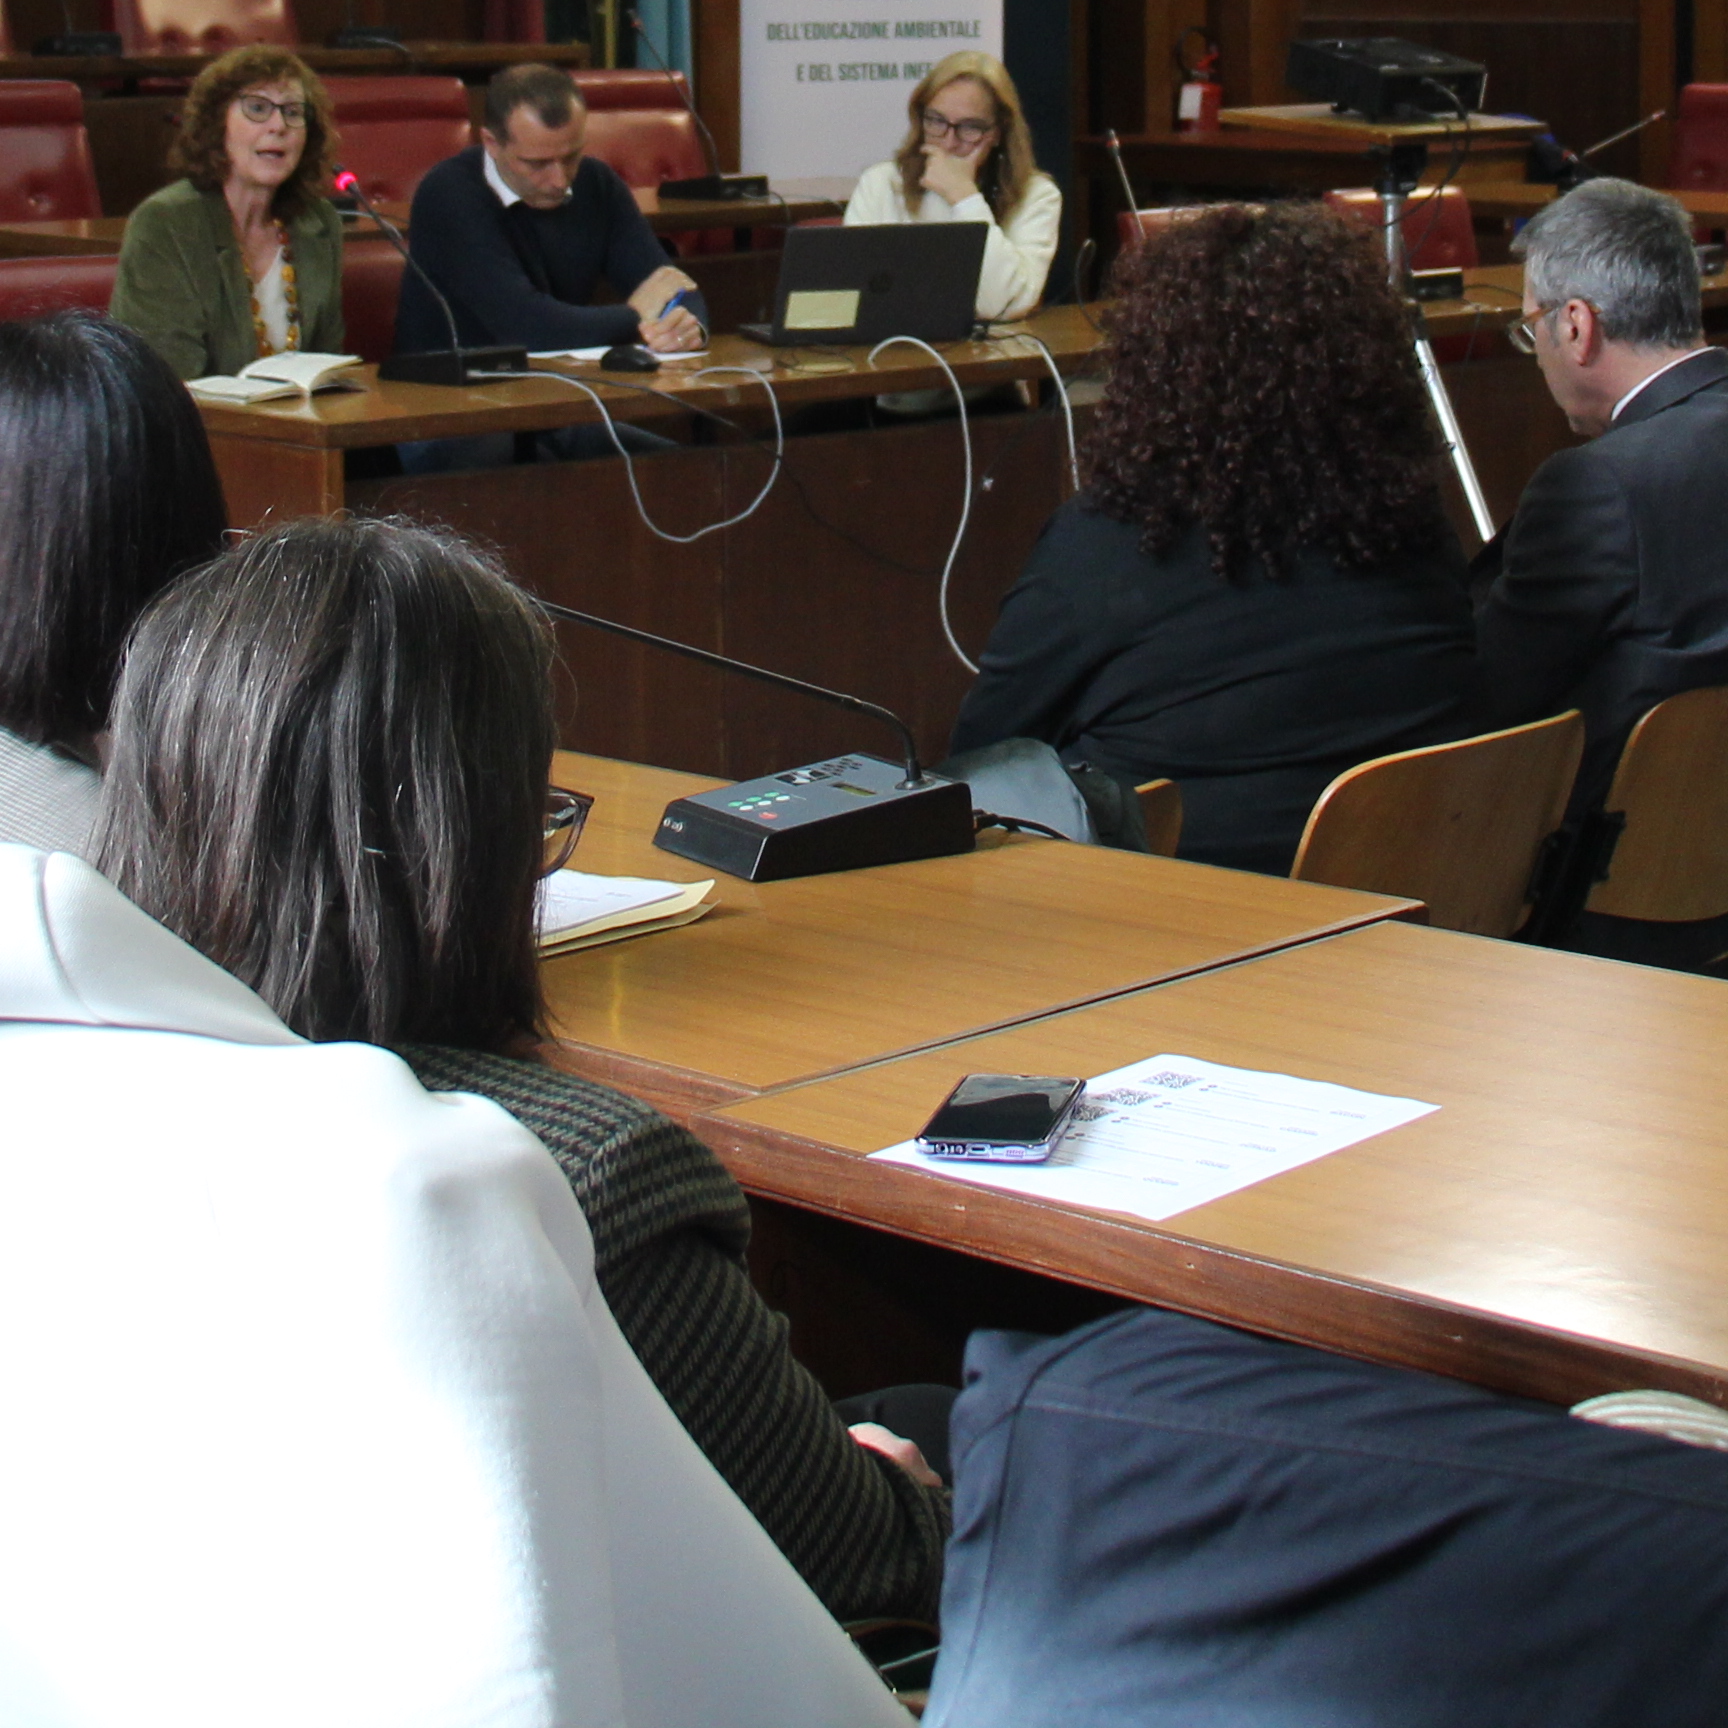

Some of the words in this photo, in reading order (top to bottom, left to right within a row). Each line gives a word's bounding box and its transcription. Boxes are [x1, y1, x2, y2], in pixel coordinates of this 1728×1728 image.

[766, 22, 890, 41] DELL'EDUCAZIONE
[894, 21, 981, 39] AMBIENTALE
[796, 63, 805, 82] E
[808, 63, 834, 82] DEL
[838, 62, 899, 81] SISTEMA
